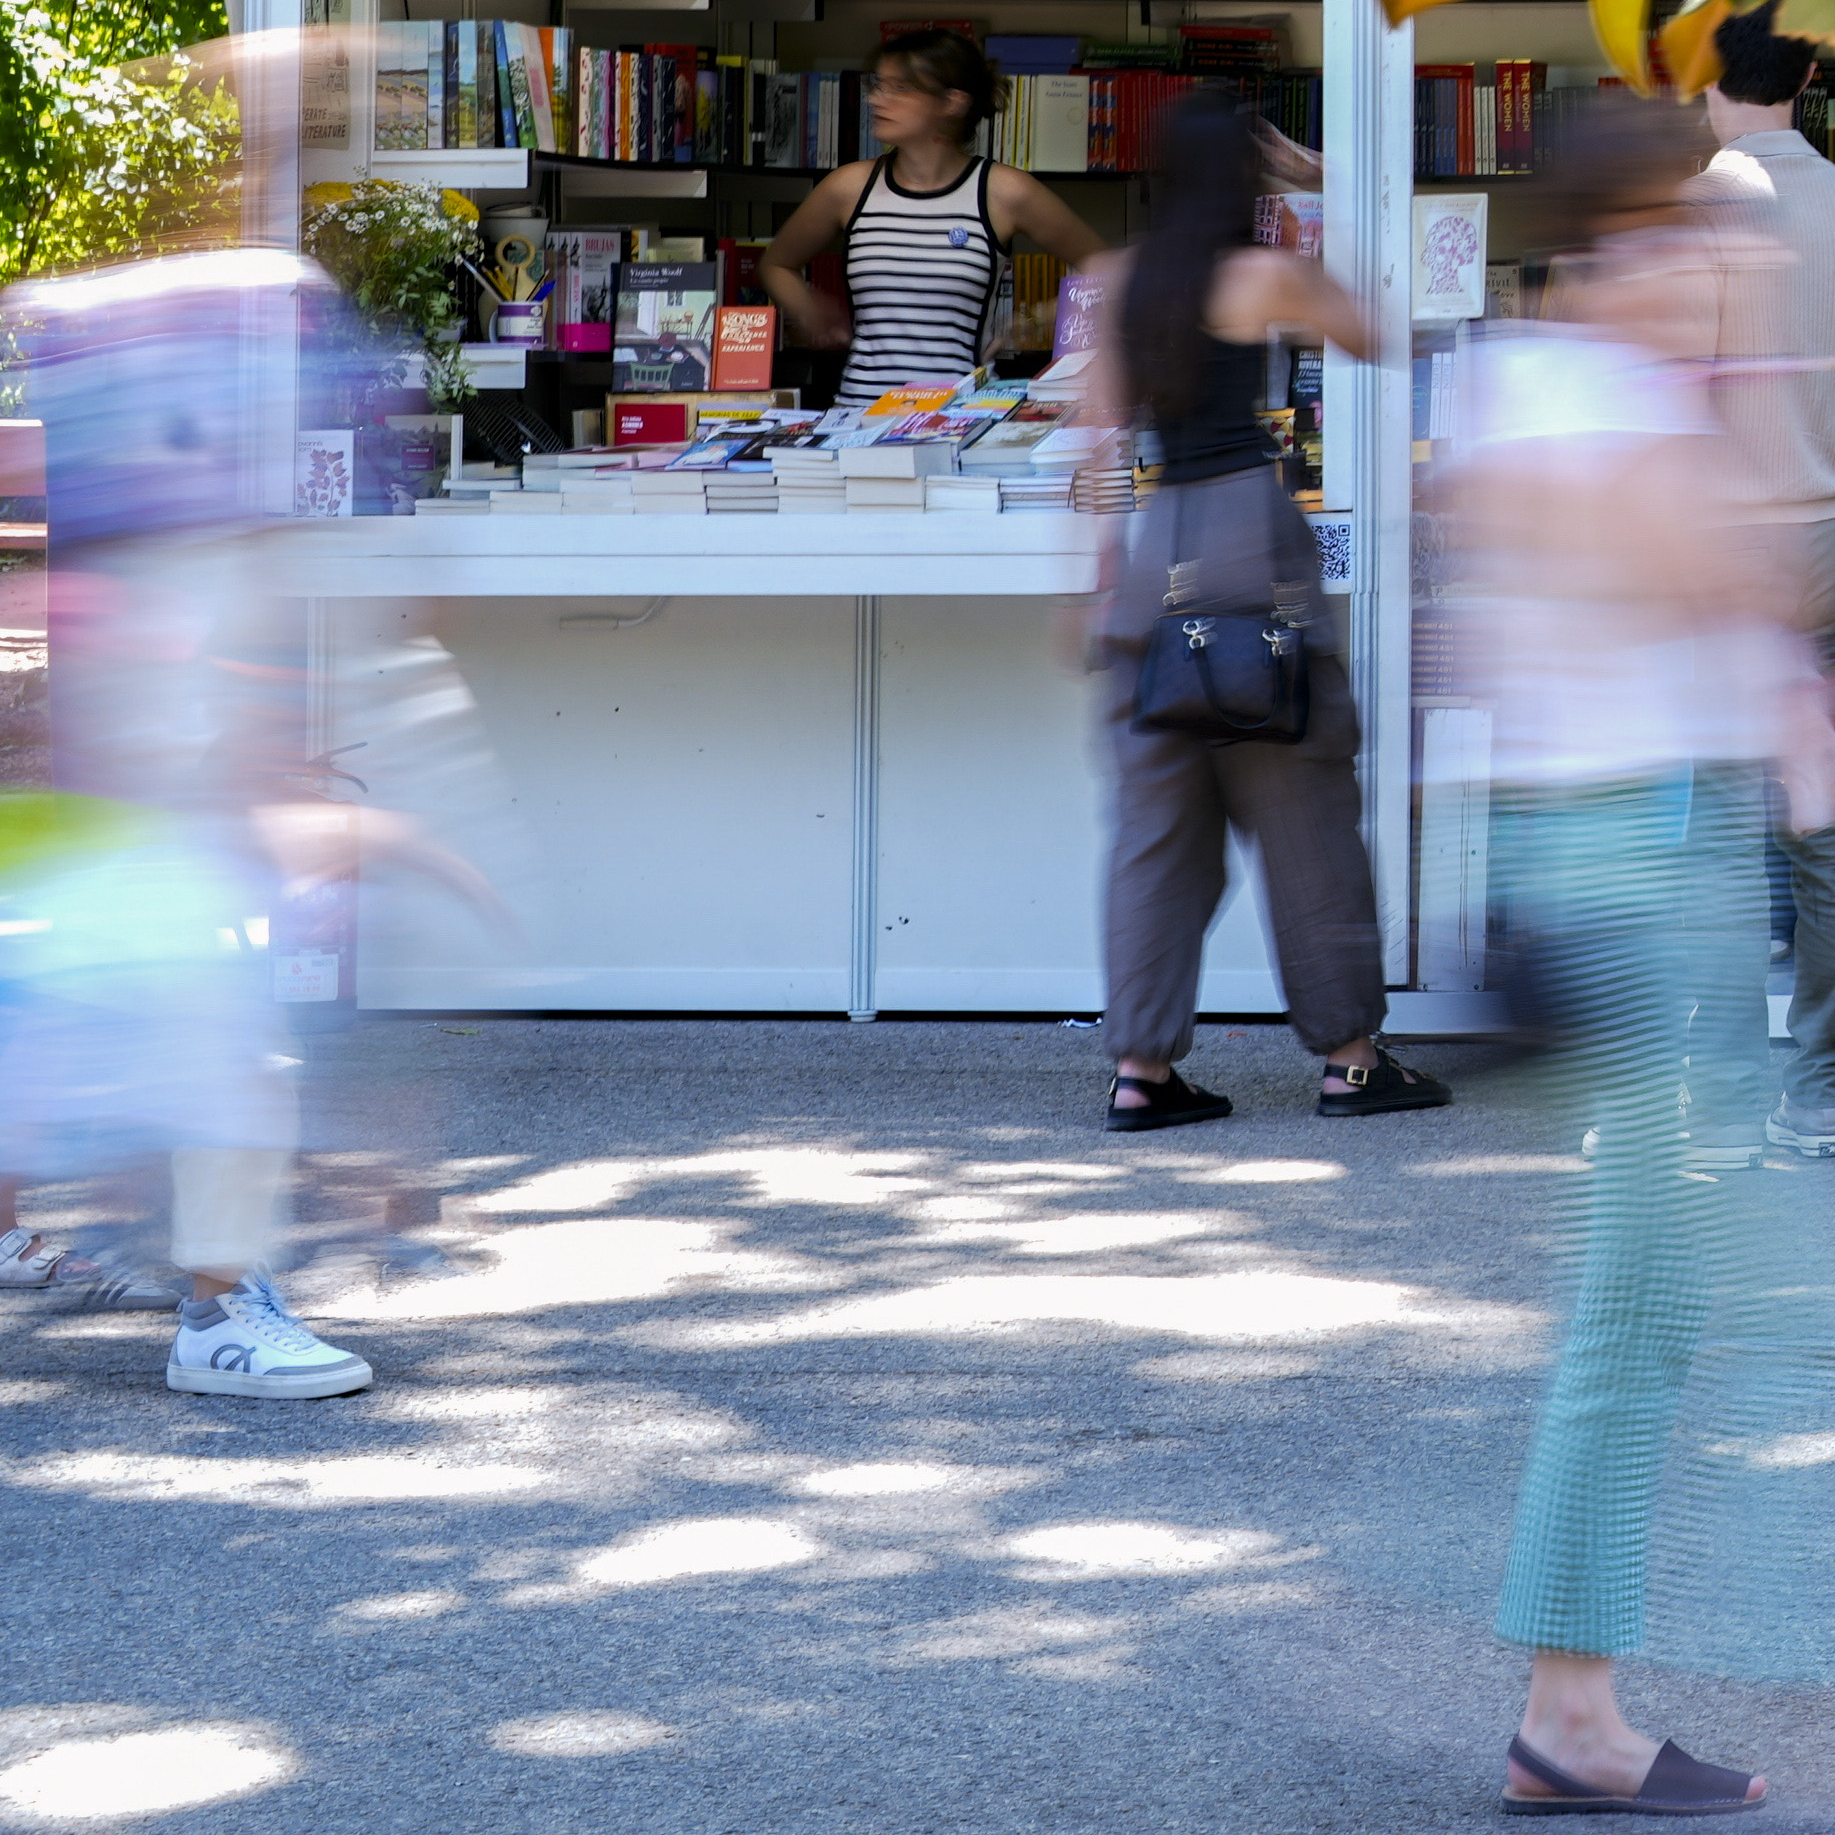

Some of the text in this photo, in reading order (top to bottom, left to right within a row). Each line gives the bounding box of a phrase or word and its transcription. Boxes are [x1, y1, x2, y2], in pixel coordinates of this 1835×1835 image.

[1503, 71, 1513, 133] THE WOMEN
[1521, 71, 1531, 133] THE WOMEN
[585, 238, 616, 252] BRUJAS
[629, 267, 660, 278] Virginia
